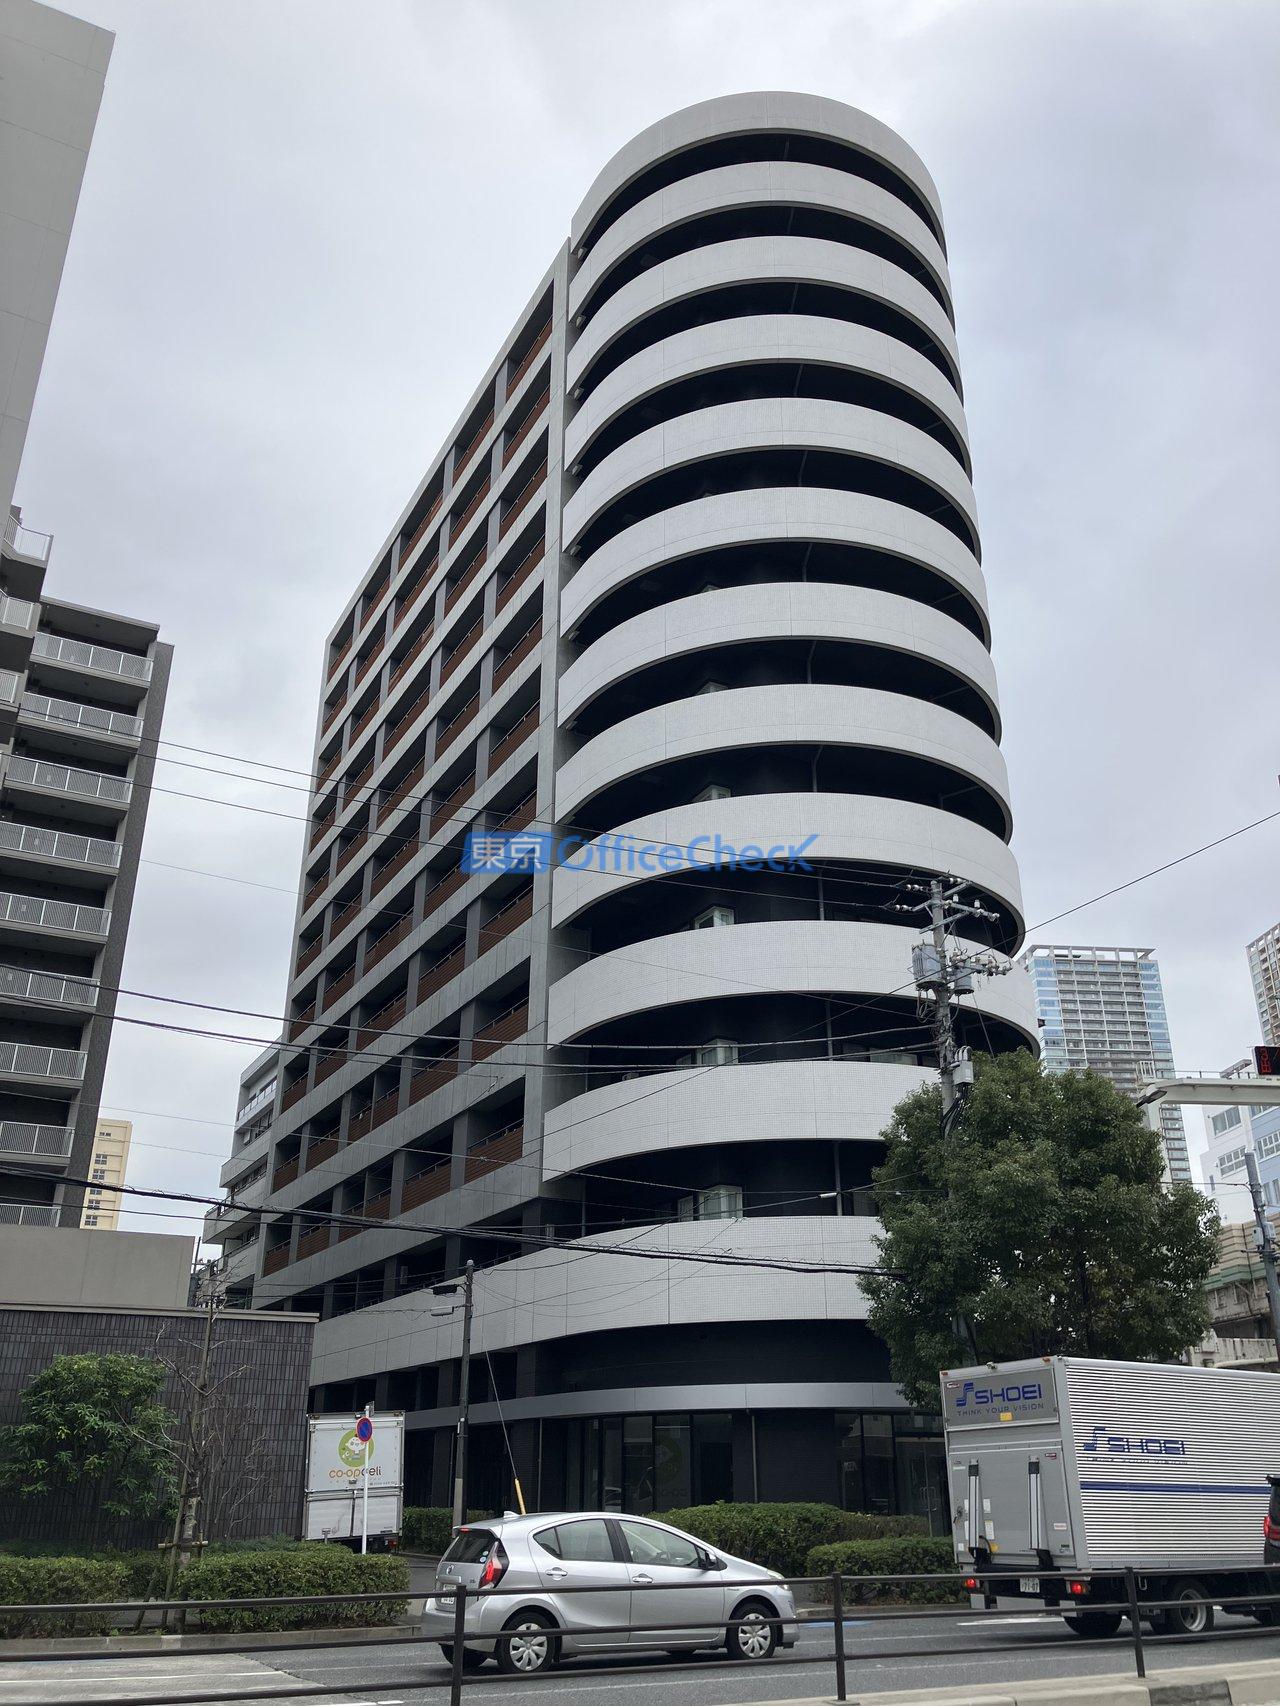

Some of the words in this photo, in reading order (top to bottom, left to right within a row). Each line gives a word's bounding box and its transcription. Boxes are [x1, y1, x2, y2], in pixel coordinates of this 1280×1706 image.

[975, 1383, 1042, 1404] SHOEI
[1013, 1403, 1044, 1412] VISION
[1108, 1437, 1185, 1454] SHOEI
